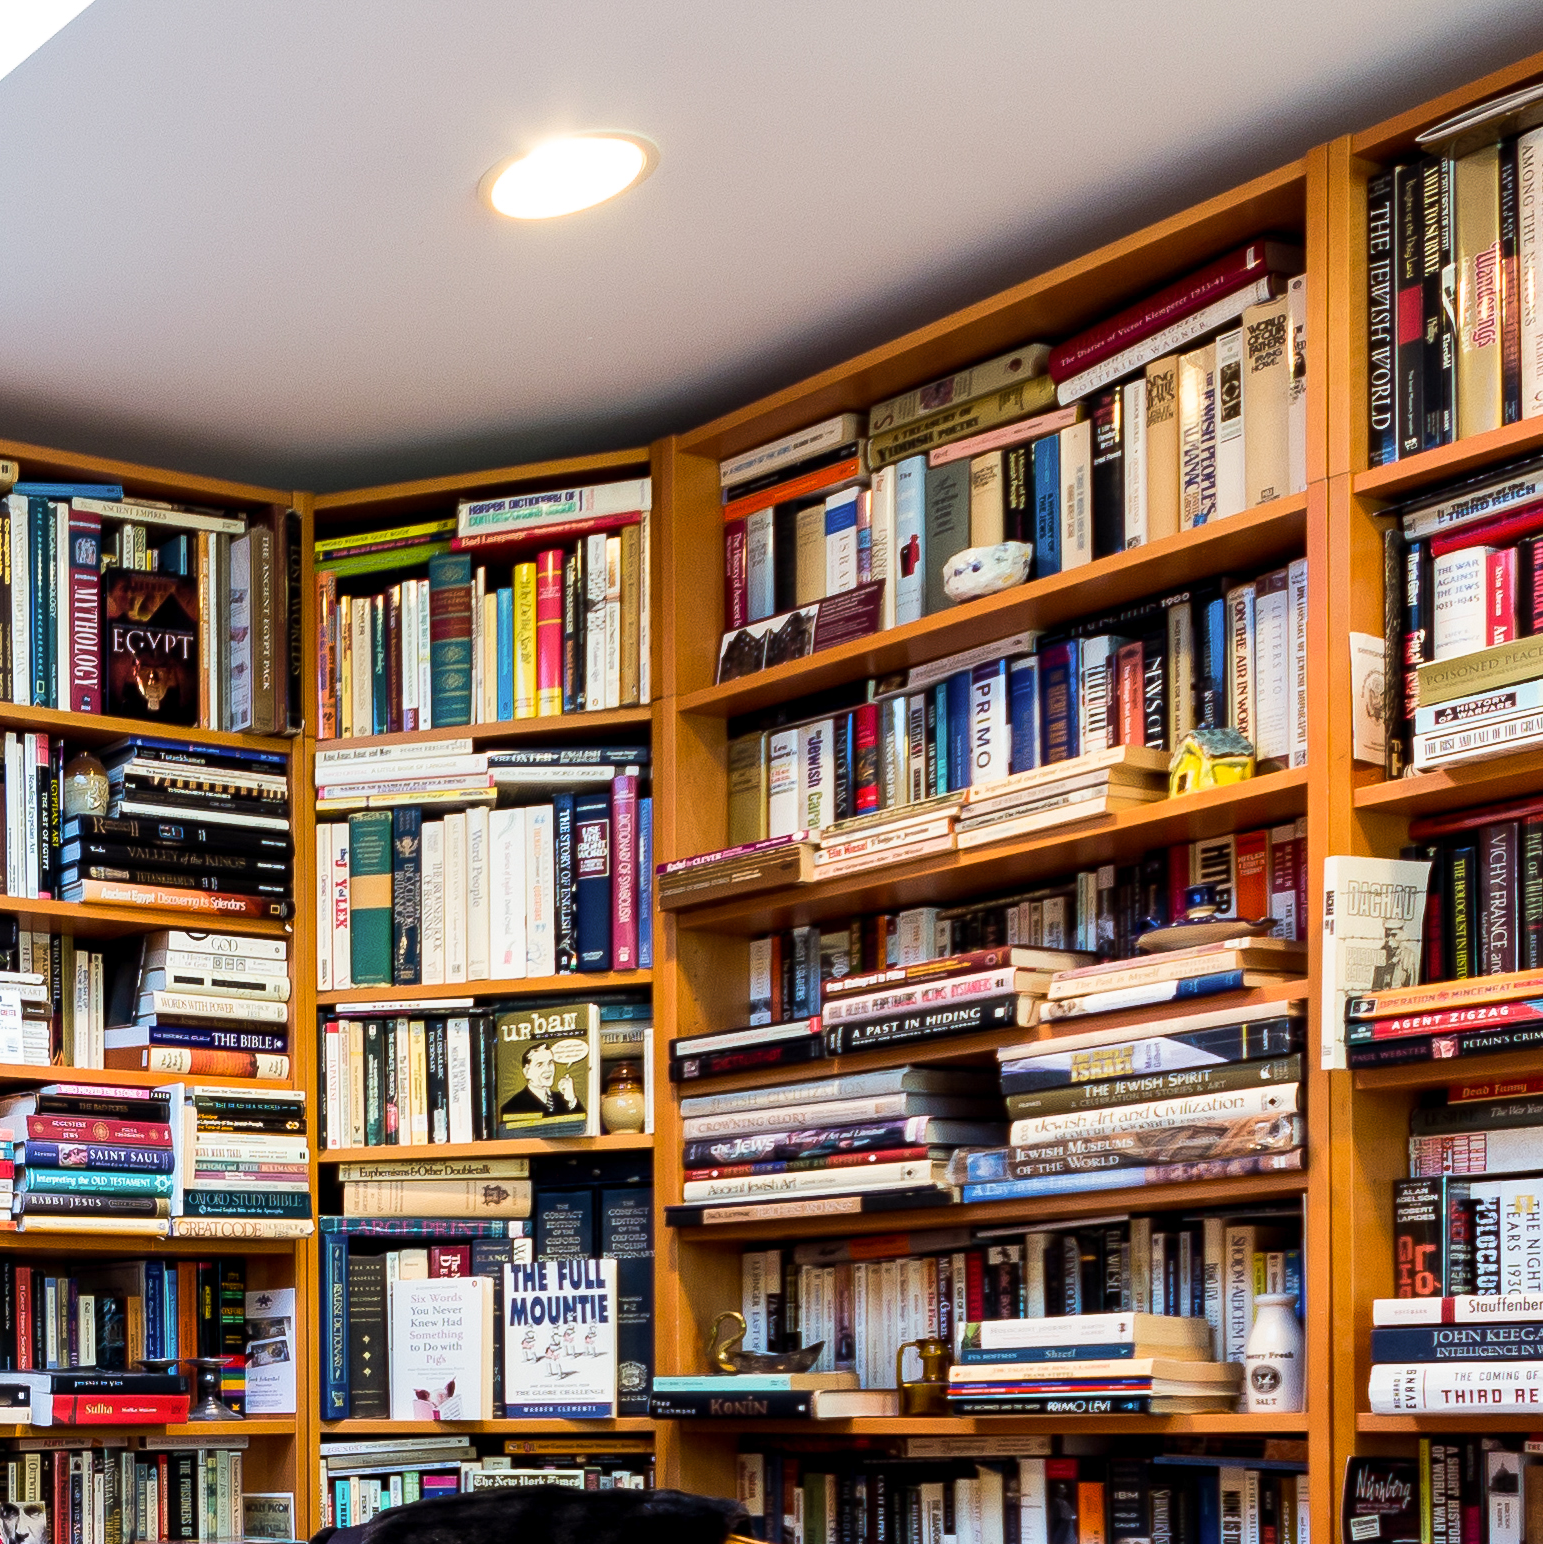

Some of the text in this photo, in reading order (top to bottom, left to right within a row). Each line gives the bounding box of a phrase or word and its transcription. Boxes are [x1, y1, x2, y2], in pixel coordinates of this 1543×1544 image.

[1370, 201, 1390, 430] THE JEWISH WORLD
[74, 585, 99, 692] MYTHOLOGY
[112, 628, 195, 660] EGYPT
[1348, 880, 1418, 921] DACHAU
[852, 1008, 981, 1039] A PAST IN HIDING
[1392, 1005, 1510, 1031] AGENT ZIGZAG
[212, 1032, 273, 1049] THE BIBLE
[89, 1149, 159, 1164] SAINT SAUL
[511, 1260, 606, 1291] THE FULL
[410, 1304, 463, 1316] You Never
[431, 1293, 463, 1304] Words
[509, 1294, 609, 1327] MOUNTIE
[408, 1329, 464, 1341] Something
[410, 1316, 463, 1328] Knew Had
[410, 1340, 463, 1352] to Do with
